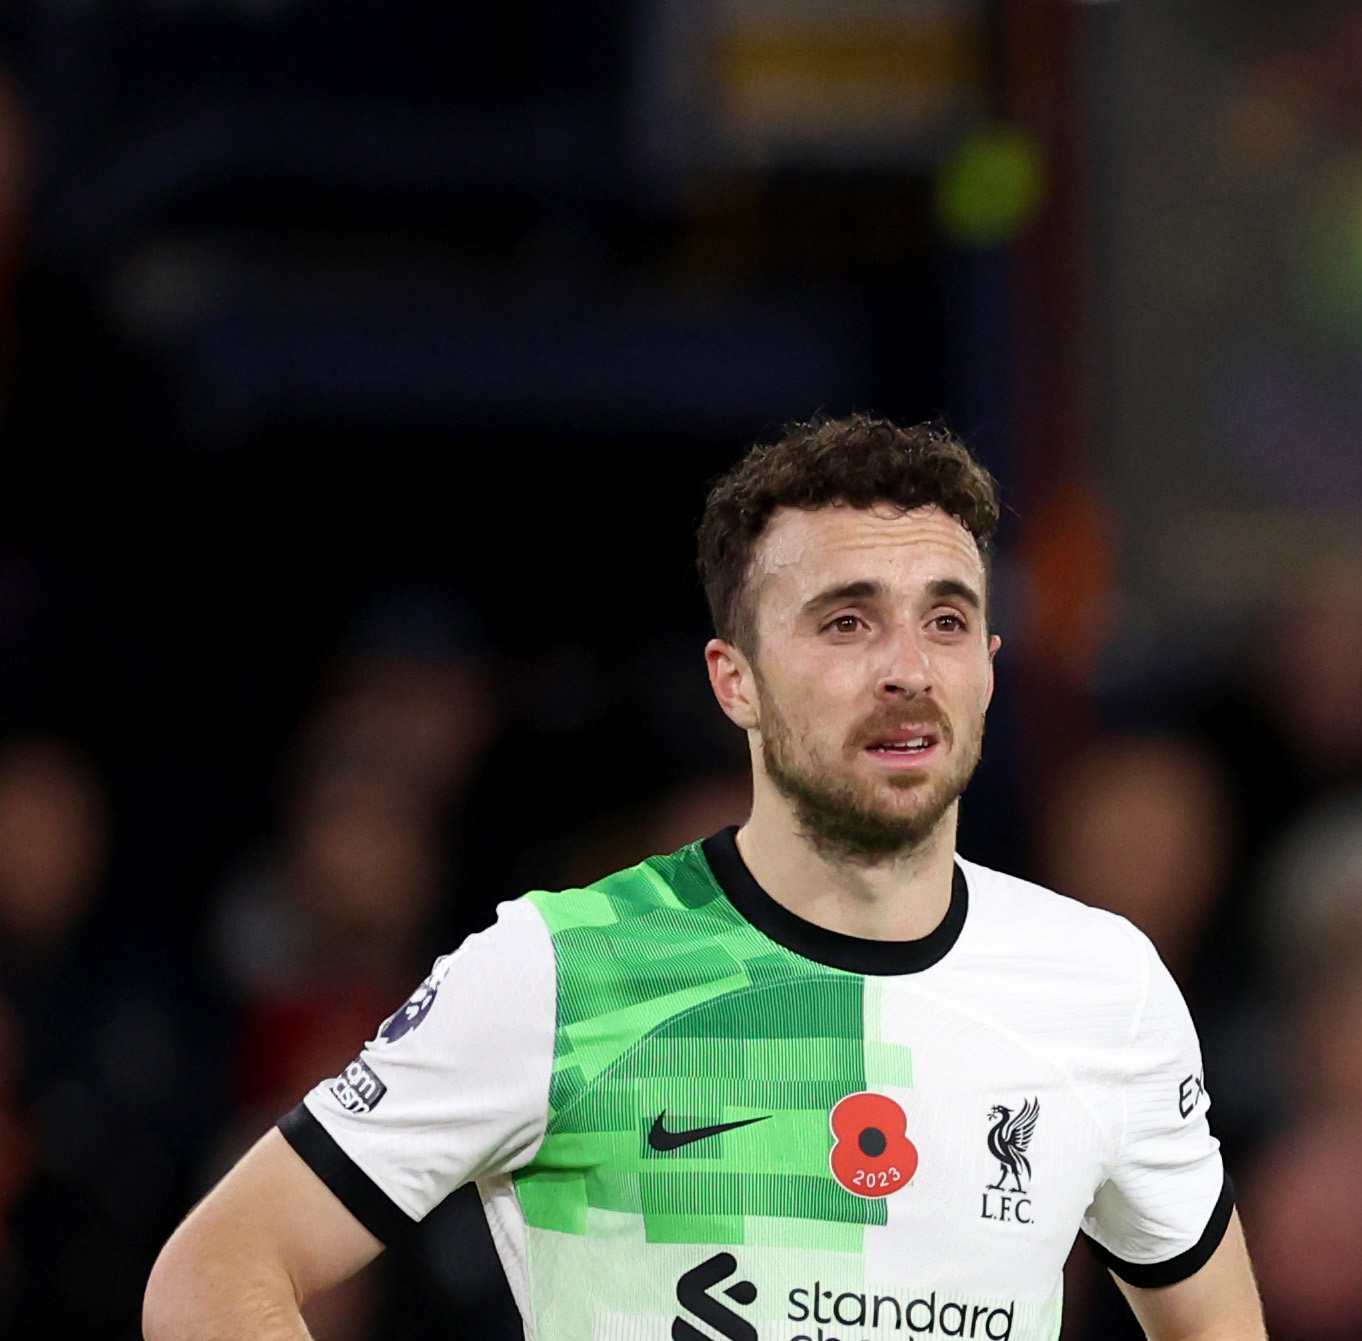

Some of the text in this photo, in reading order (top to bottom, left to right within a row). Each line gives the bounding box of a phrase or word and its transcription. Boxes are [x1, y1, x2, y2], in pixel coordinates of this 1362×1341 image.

[853, 1167, 900, 1188] 2023
[981, 1194, 1035, 1224] L.F.C.
[788, 1281, 1015, 1341] standard
